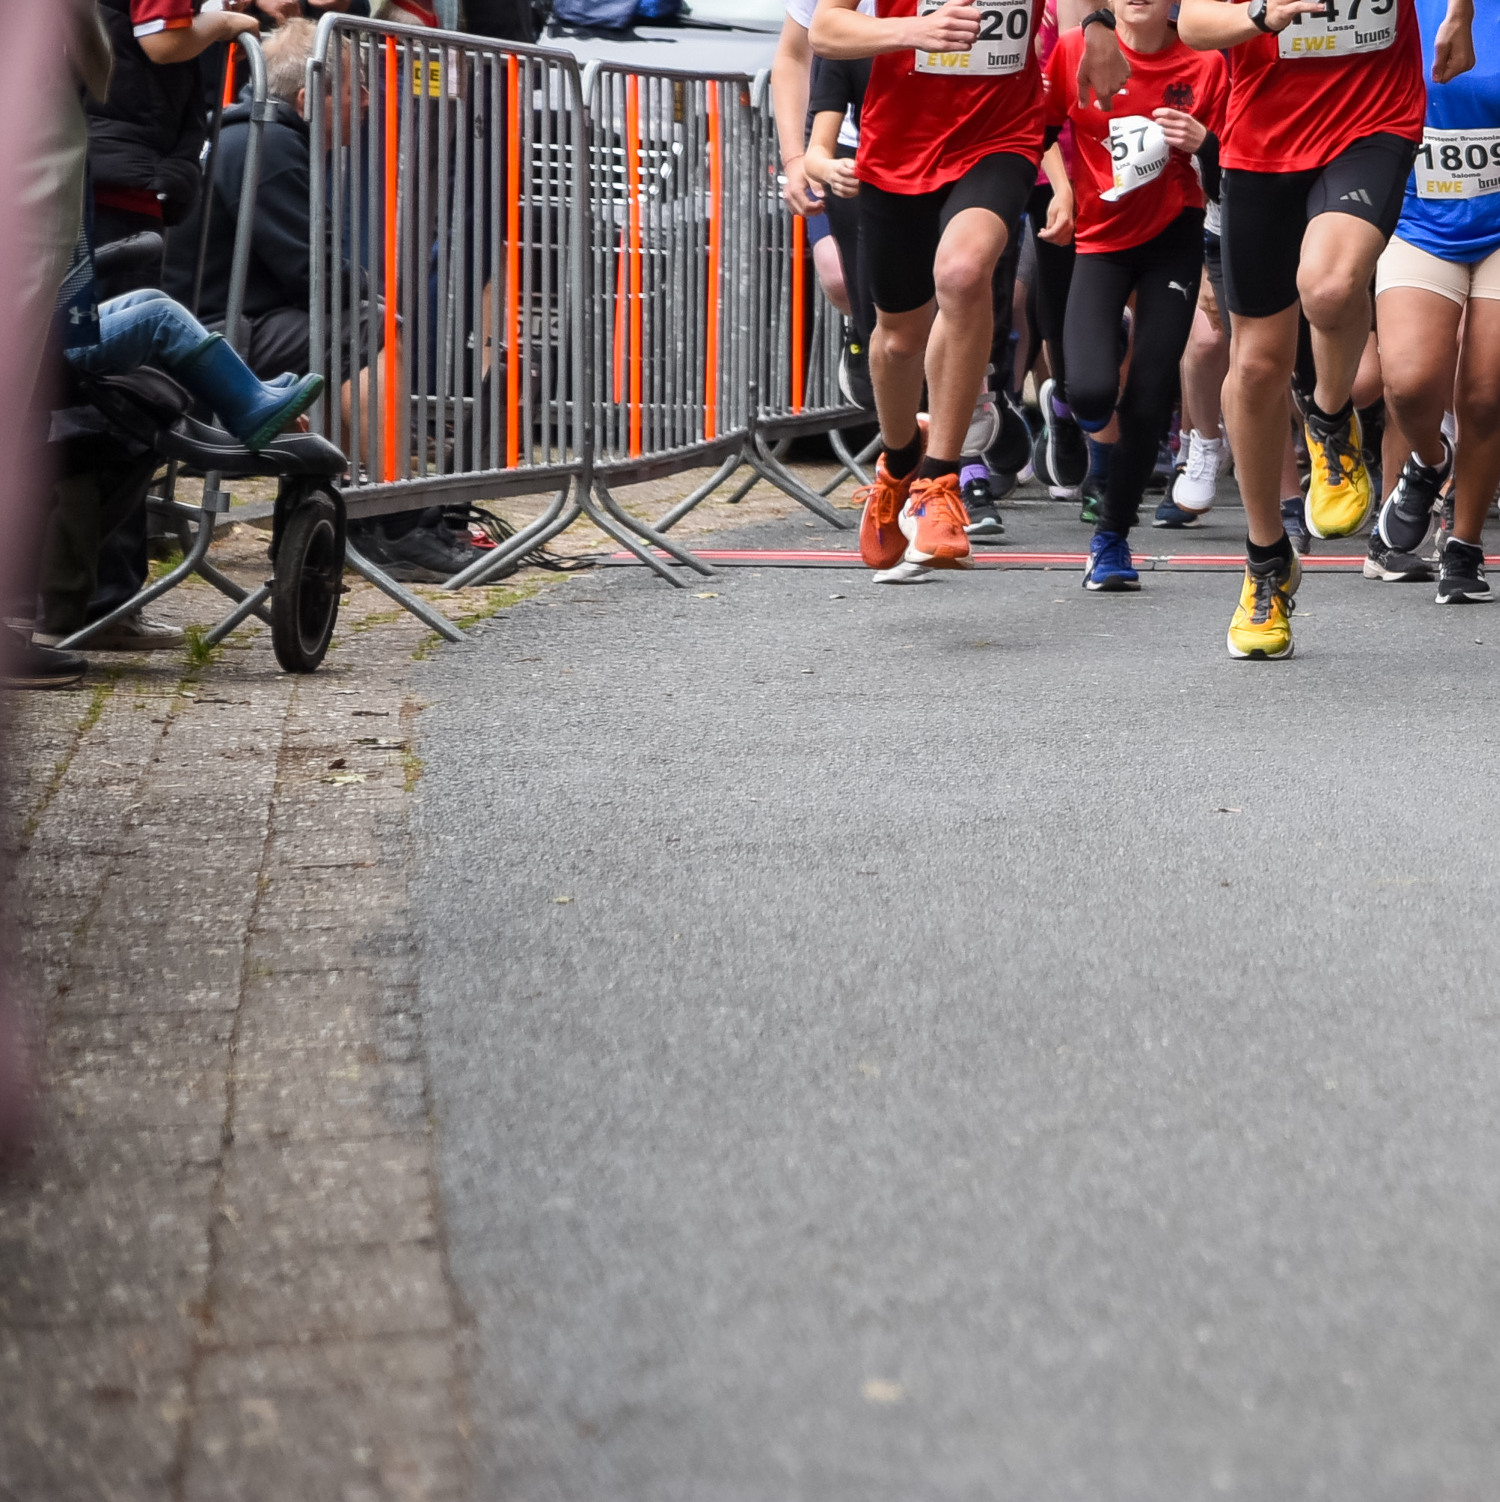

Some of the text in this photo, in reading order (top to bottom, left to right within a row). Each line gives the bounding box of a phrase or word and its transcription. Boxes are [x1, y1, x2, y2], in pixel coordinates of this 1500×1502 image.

[1326, 24, 1355, 32] Lasse
[1291, 35, 1337, 52] EWE
[1354, 27, 1391, 45] bruns
[927, 52, 1020, 68] EWE bruns
[1426, 180, 1463, 193] EWE
